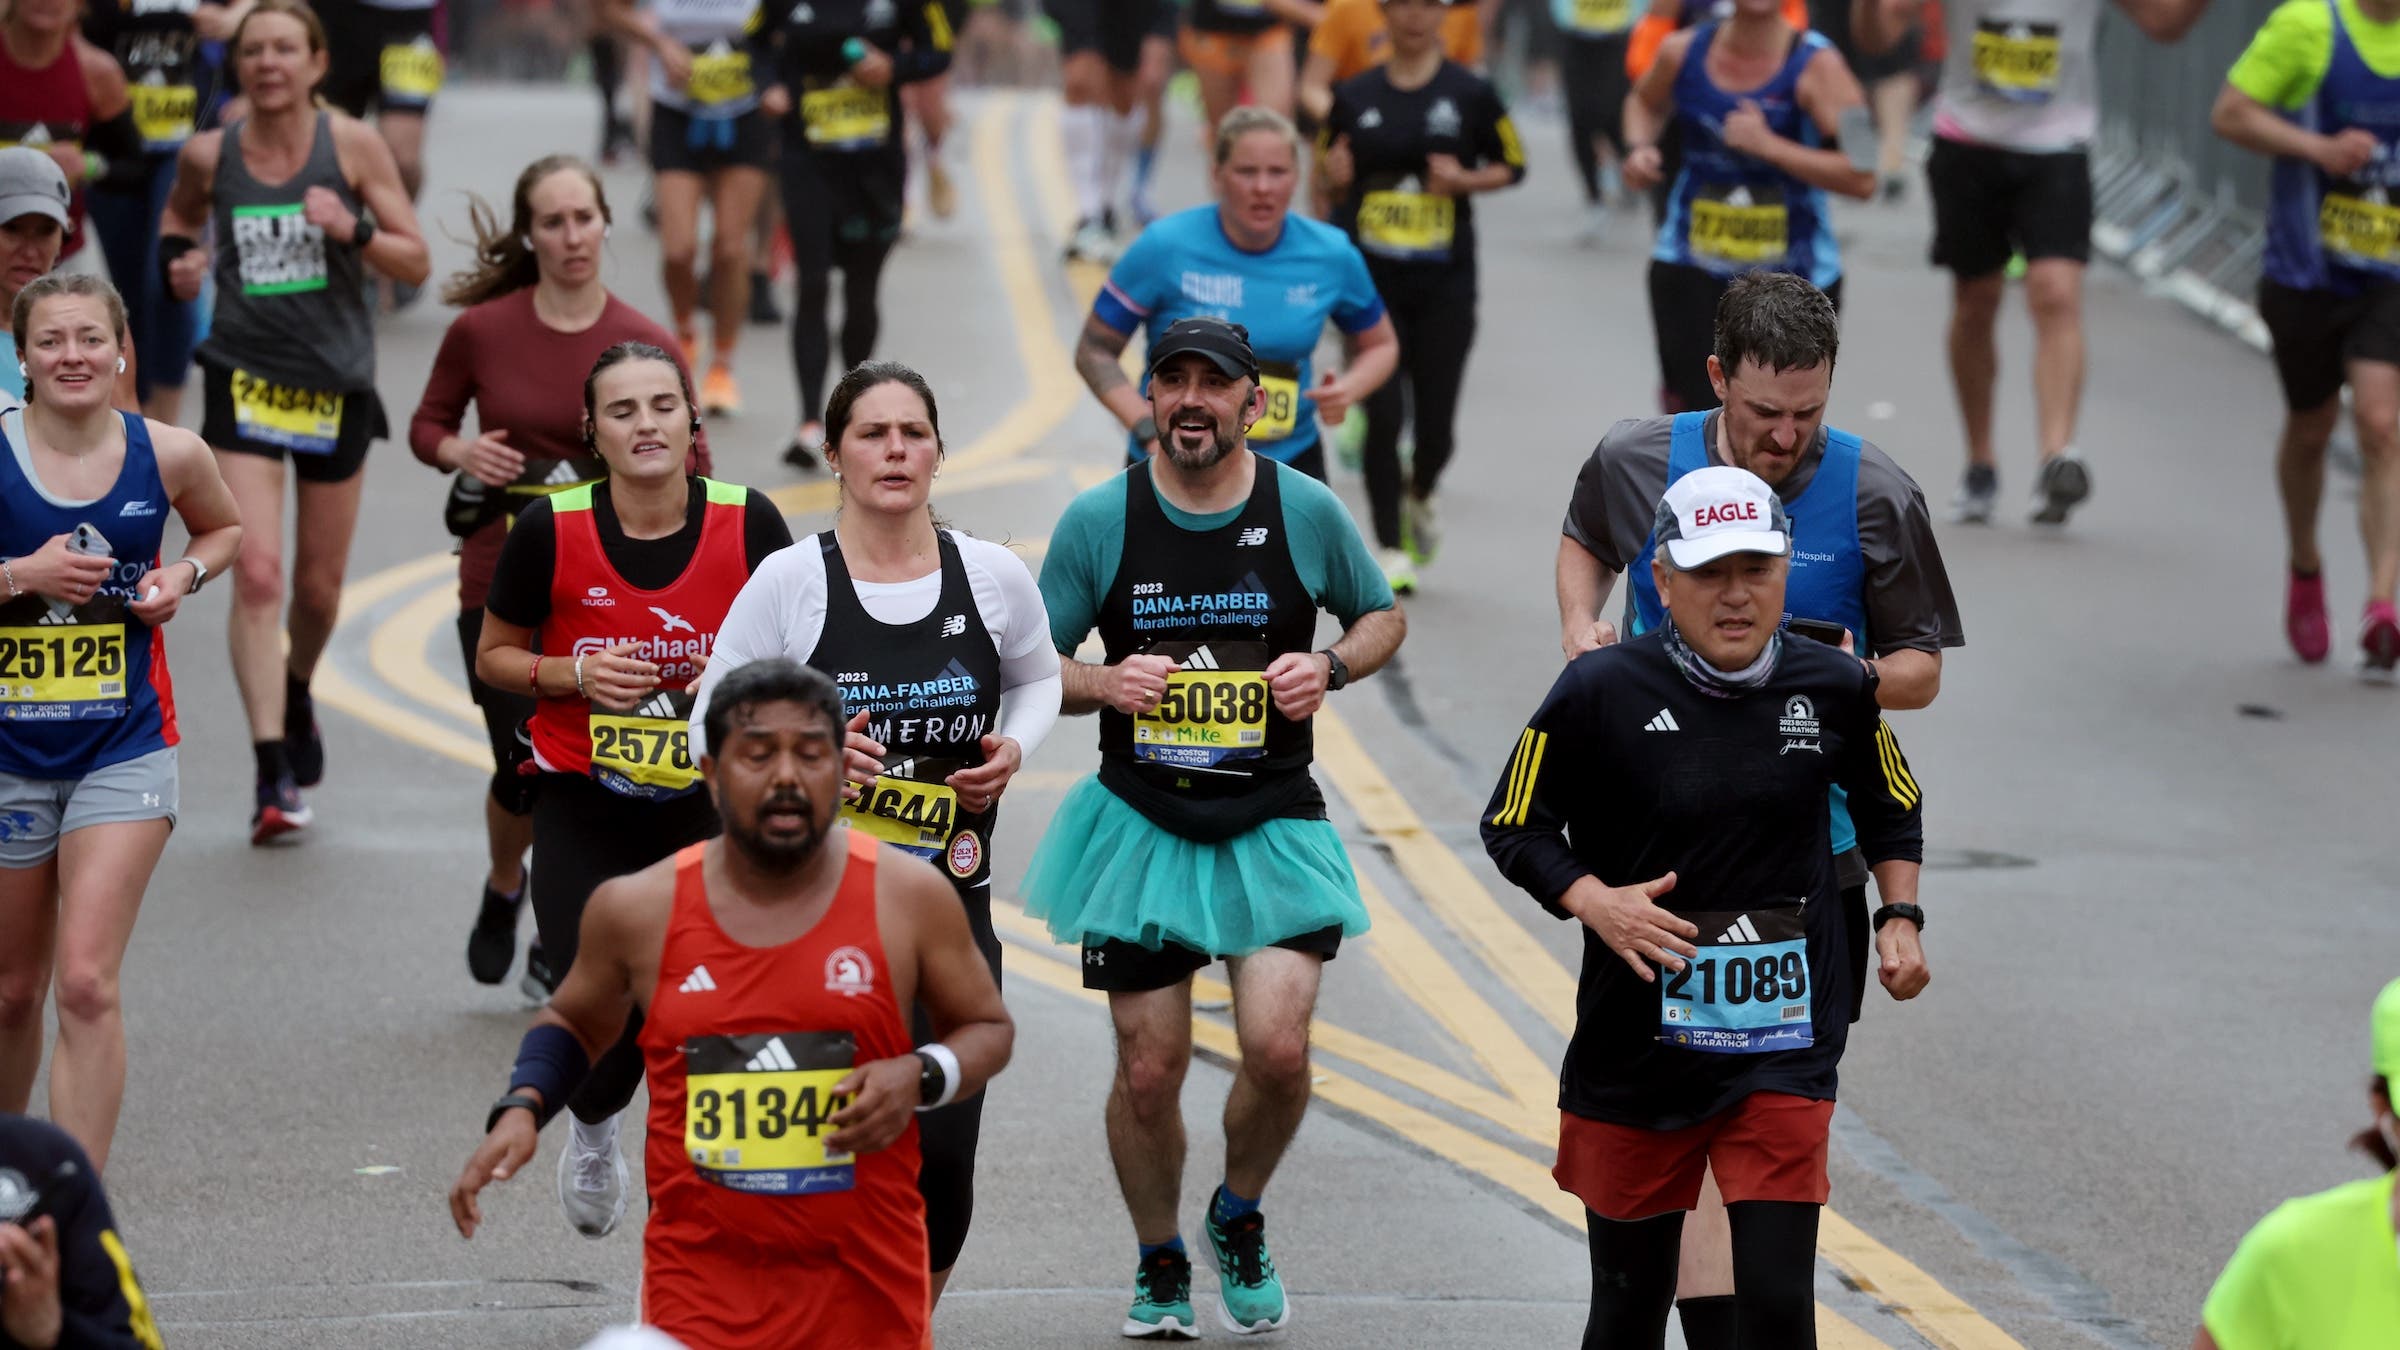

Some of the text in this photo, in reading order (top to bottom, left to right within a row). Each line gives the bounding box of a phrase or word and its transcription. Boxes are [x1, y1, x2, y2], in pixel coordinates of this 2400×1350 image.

[1695, 502, 1758, 527] EAGLE
[1797, 550, 1835, 562] Hospital
[1133, 583, 1163, 595] 2023
[1133, 592, 1268, 616] DANA-FARBER
[1133, 612, 1269, 630] Marathon Challenge
[0, 635, 121, 679] 25125
[836, 672, 869, 683] 2023
[836, 676, 975, 701] DANA-FARBER
[842, 693, 977, 715] arathon Challenge
[1137, 682, 1264, 724] 5038
[21, 711, 70, 719] MARATHON
[1140, 729, 1148, 738] 2
[1177, 727, 1222, 743] Mike
[1779, 726, 1820, 734] MARATHON
[594, 725, 701, 771] 2578
[1179, 748, 1210, 757] BOSTON
[1160, 755, 1210, 764] MARATHON
[844, 781, 950, 836] 4644
[1664, 951, 1806, 1005] 21089
[1669, 1009, 1677, 1019] 6
[1713, 1032, 1749, 1040] BOSTON
[1693, 1039, 1750, 1048] MARATHON
